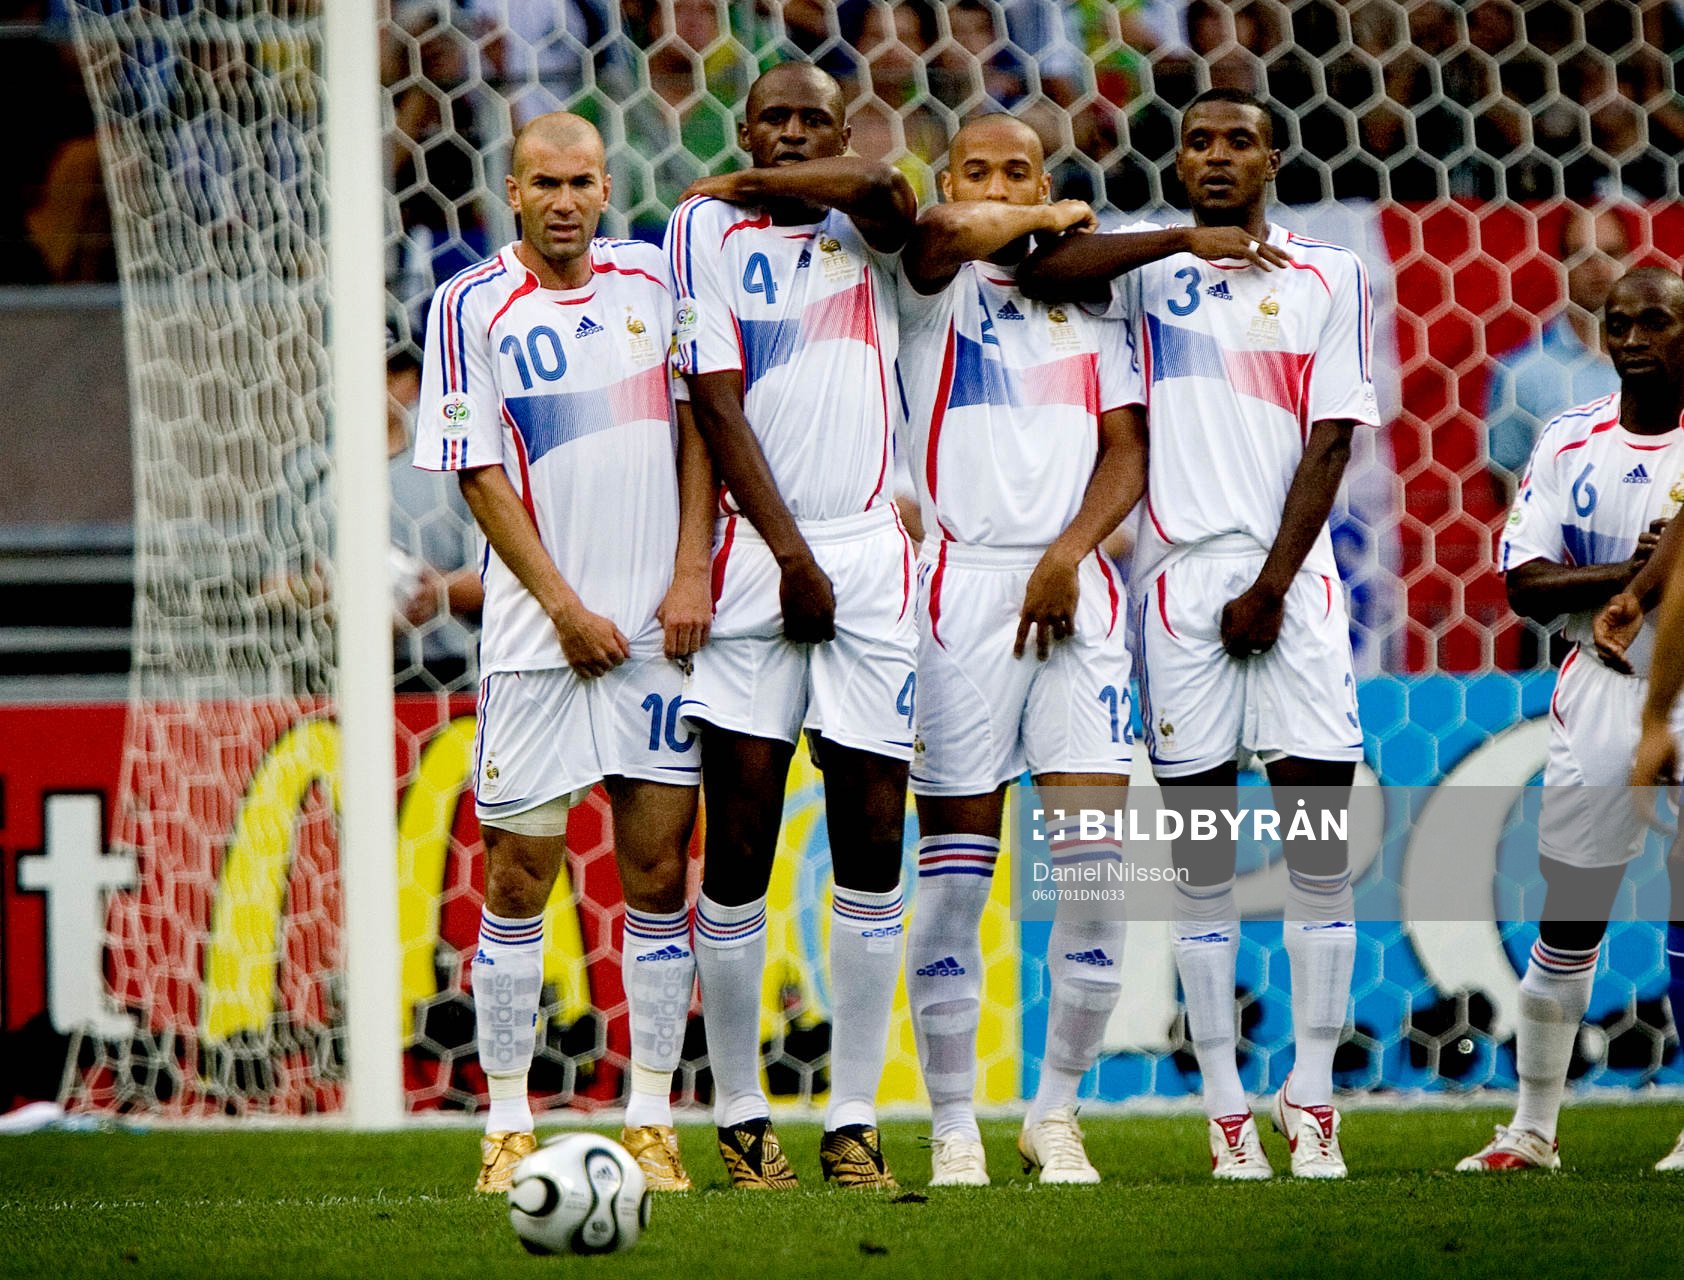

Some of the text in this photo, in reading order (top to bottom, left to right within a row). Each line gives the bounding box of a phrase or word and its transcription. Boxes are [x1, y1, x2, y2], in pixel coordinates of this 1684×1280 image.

[743, 252, 778, 304] 4
[1167, 266, 1202, 316] 3
[500, 325, 567, 391] 10
[1572, 462, 1598, 518] 6
[641, 693, 697, 753] 10
[896, 671, 917, 729] 4
[1098, 685, 1134, 745] 12
[635, 950, 691, 962] adidas
[915, 966, 967, 978] adidas
[1064, 952, 1114, 967] adidas
[490, 973, 513, 1064] adidas
[653, 966, 681, 1058] adidas
